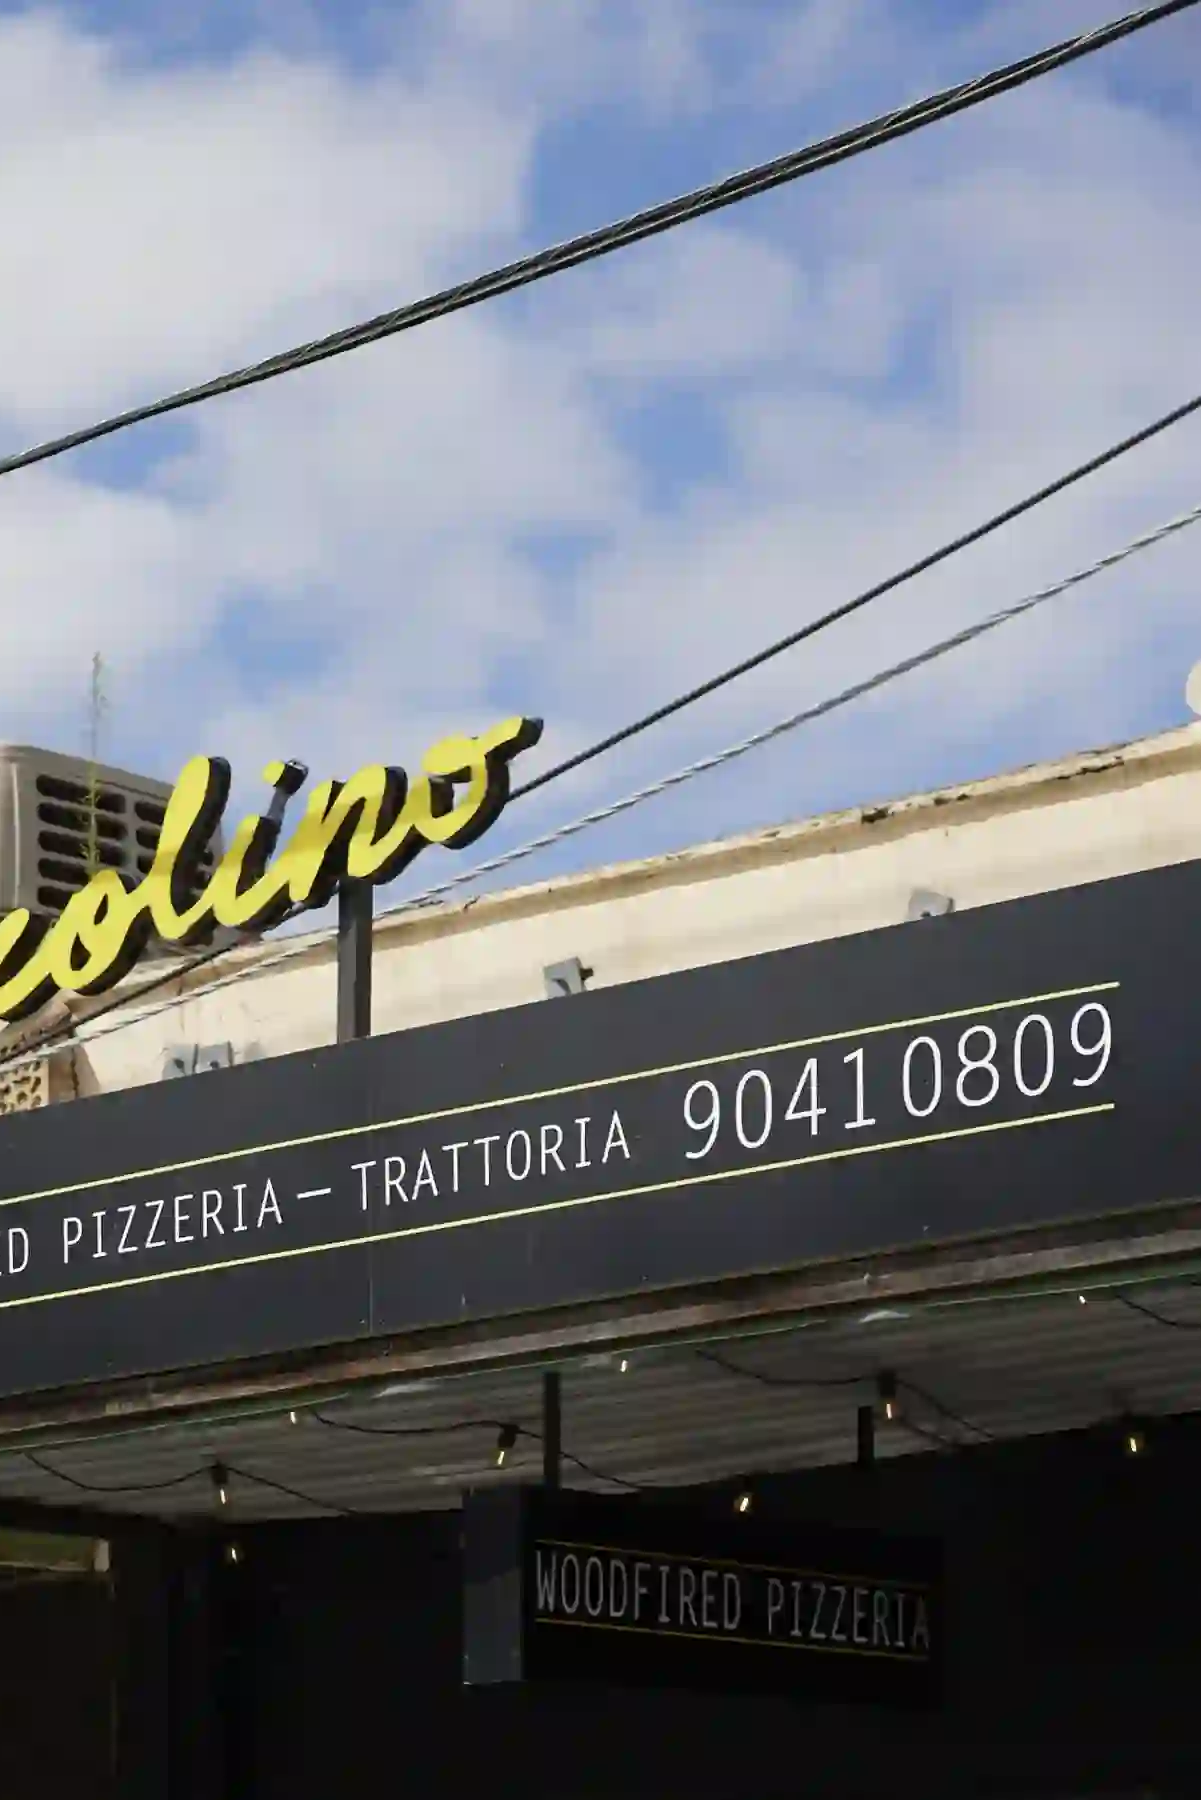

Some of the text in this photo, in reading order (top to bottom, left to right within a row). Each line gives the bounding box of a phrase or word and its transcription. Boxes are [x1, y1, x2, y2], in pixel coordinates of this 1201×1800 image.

[63, 1178, 284, 1264] PIZZERIA
[351, 1110, 631, 1211] TRATTORIA
[534, 1550, 931, 1652] WOODFIRED PIZZERIA
